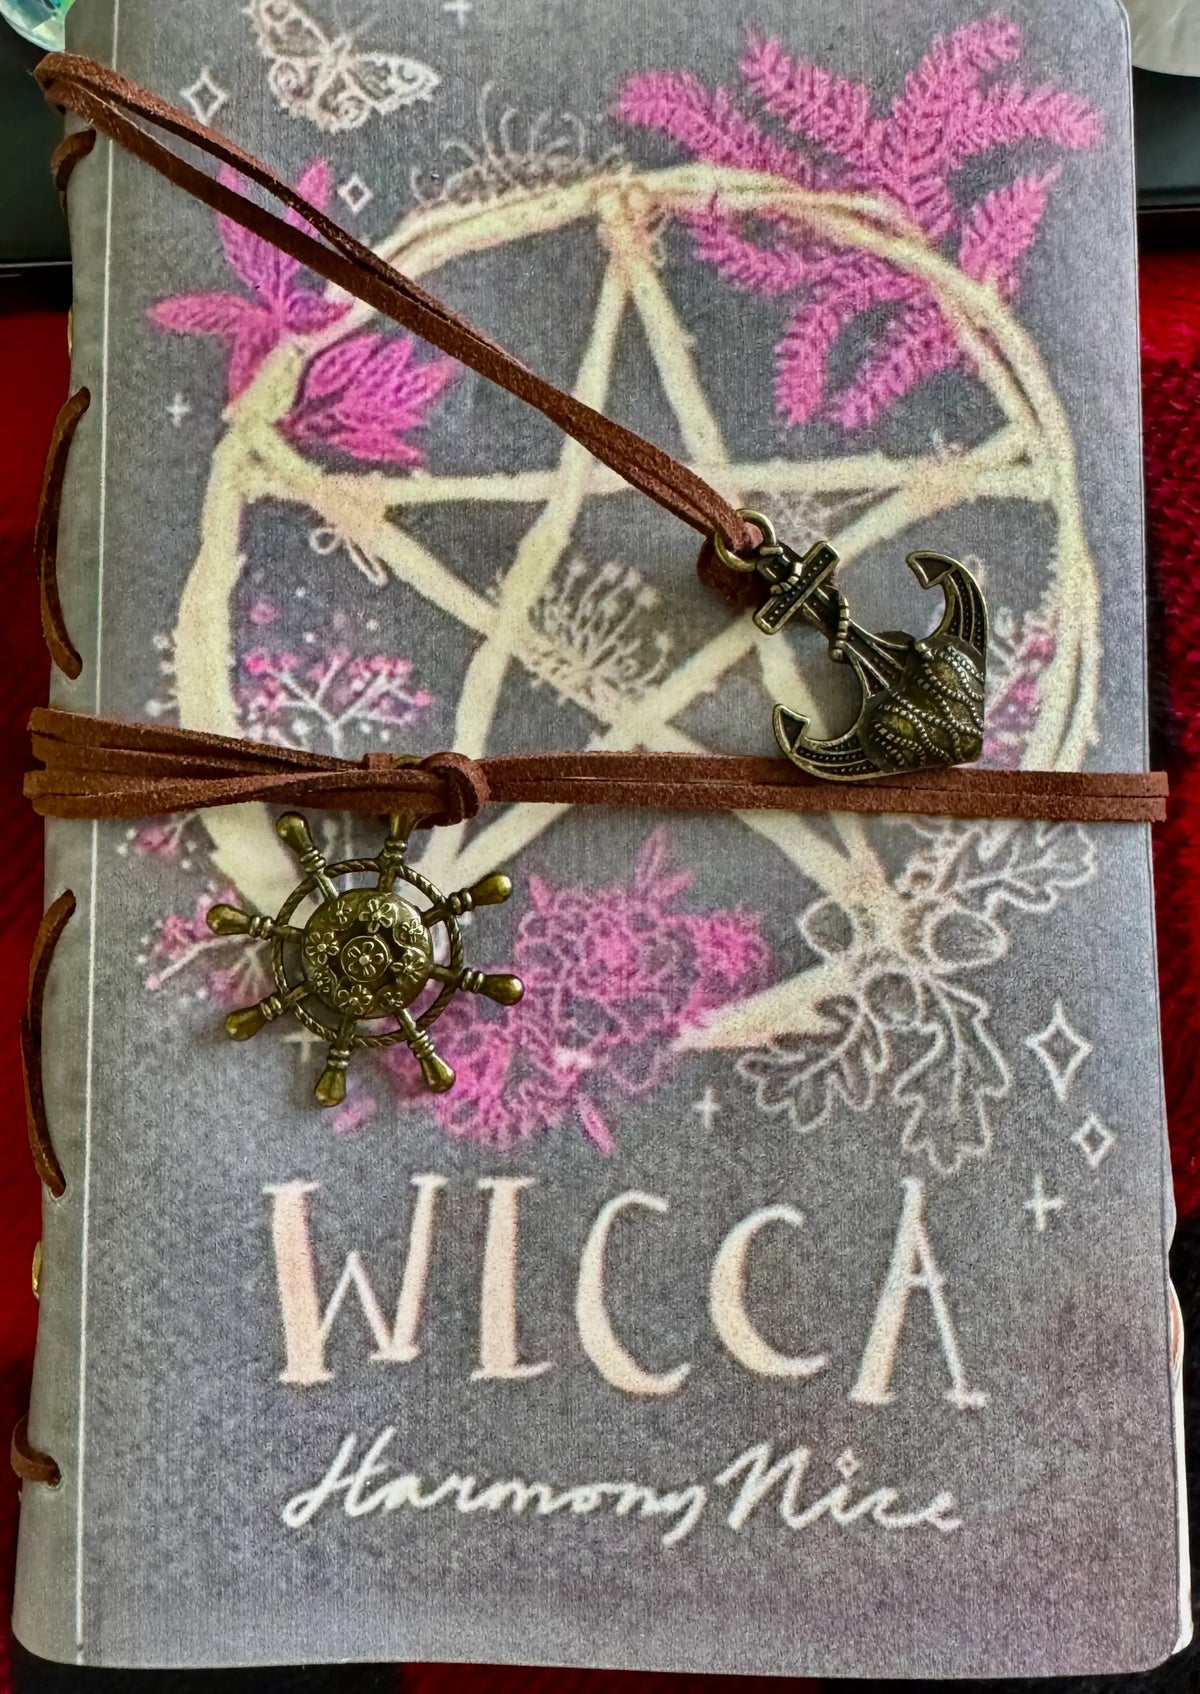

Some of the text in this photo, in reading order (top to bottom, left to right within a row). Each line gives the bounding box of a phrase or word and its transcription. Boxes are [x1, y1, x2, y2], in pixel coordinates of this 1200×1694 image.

[263, 1173, 989, 1410] WICCA
[282, 1425, 962, 1546] Harmony Nice
